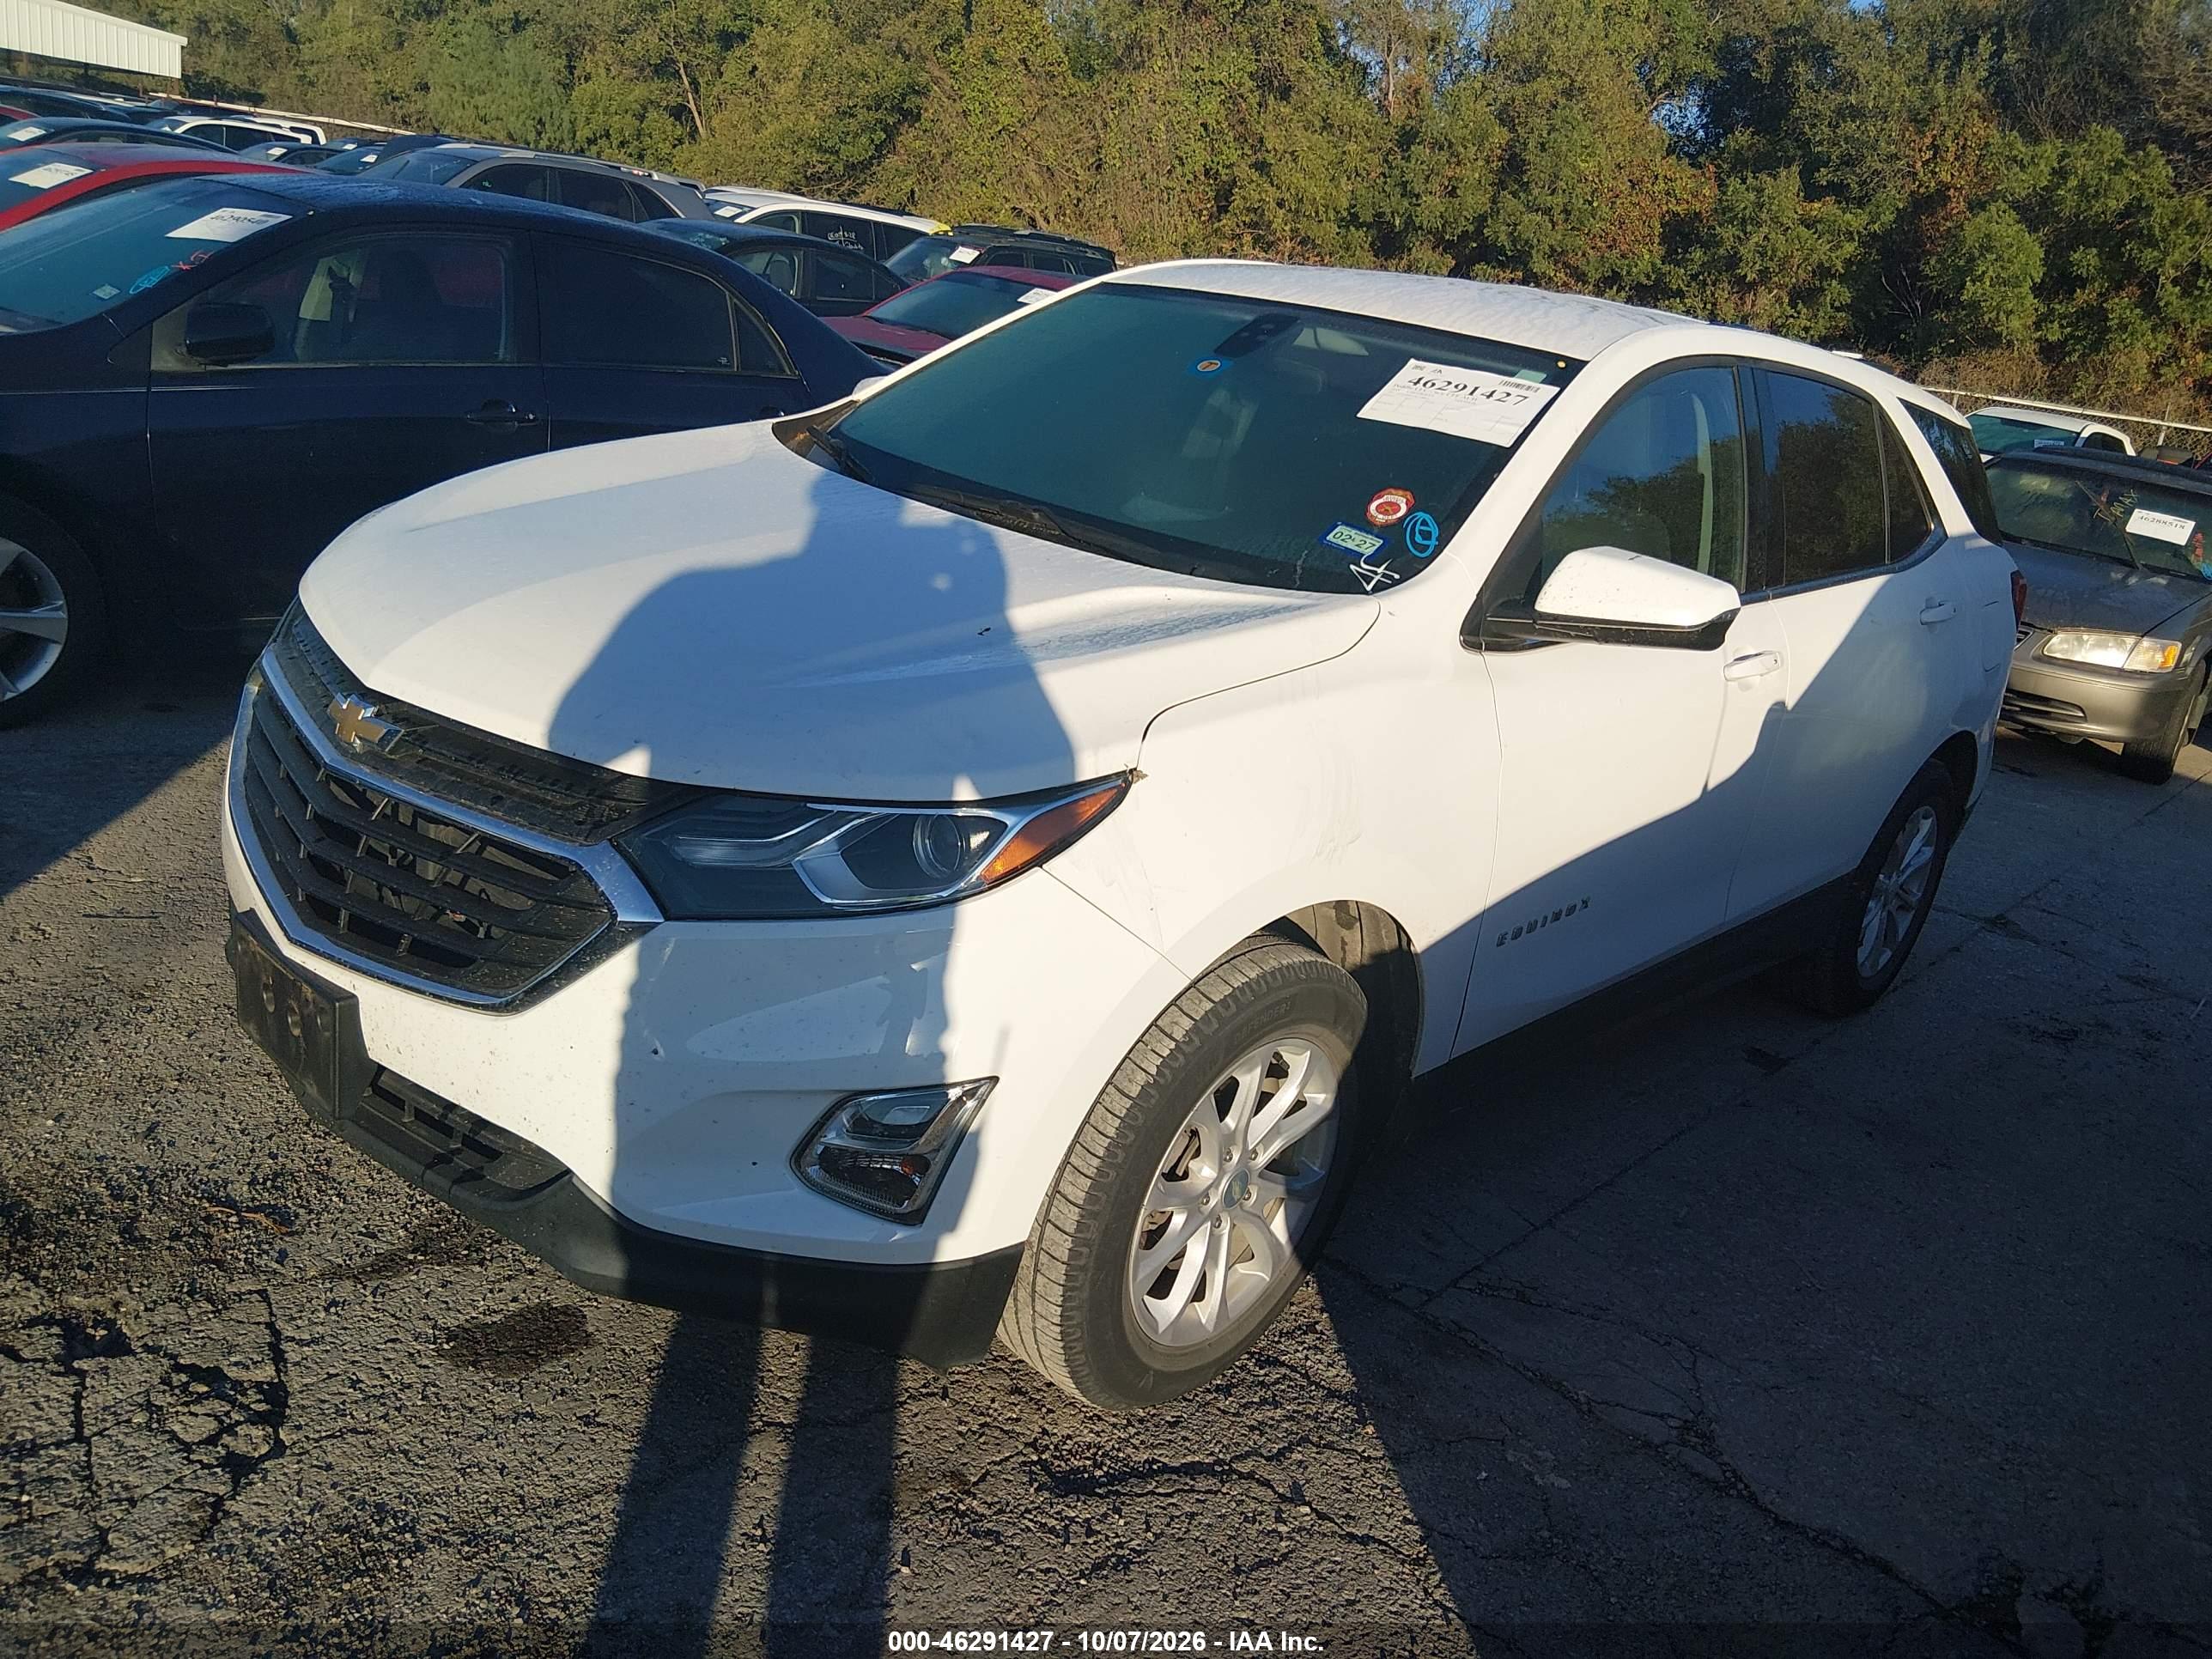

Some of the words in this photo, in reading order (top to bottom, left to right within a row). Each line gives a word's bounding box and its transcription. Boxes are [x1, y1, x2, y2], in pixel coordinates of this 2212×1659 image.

[1408, 376, 1529, 406] 46291427
[1333, 531, 1352, 544] 02
[1355, 539, 1377, 551] 27
[1496, 896, 1592, 948] EQUINOX
